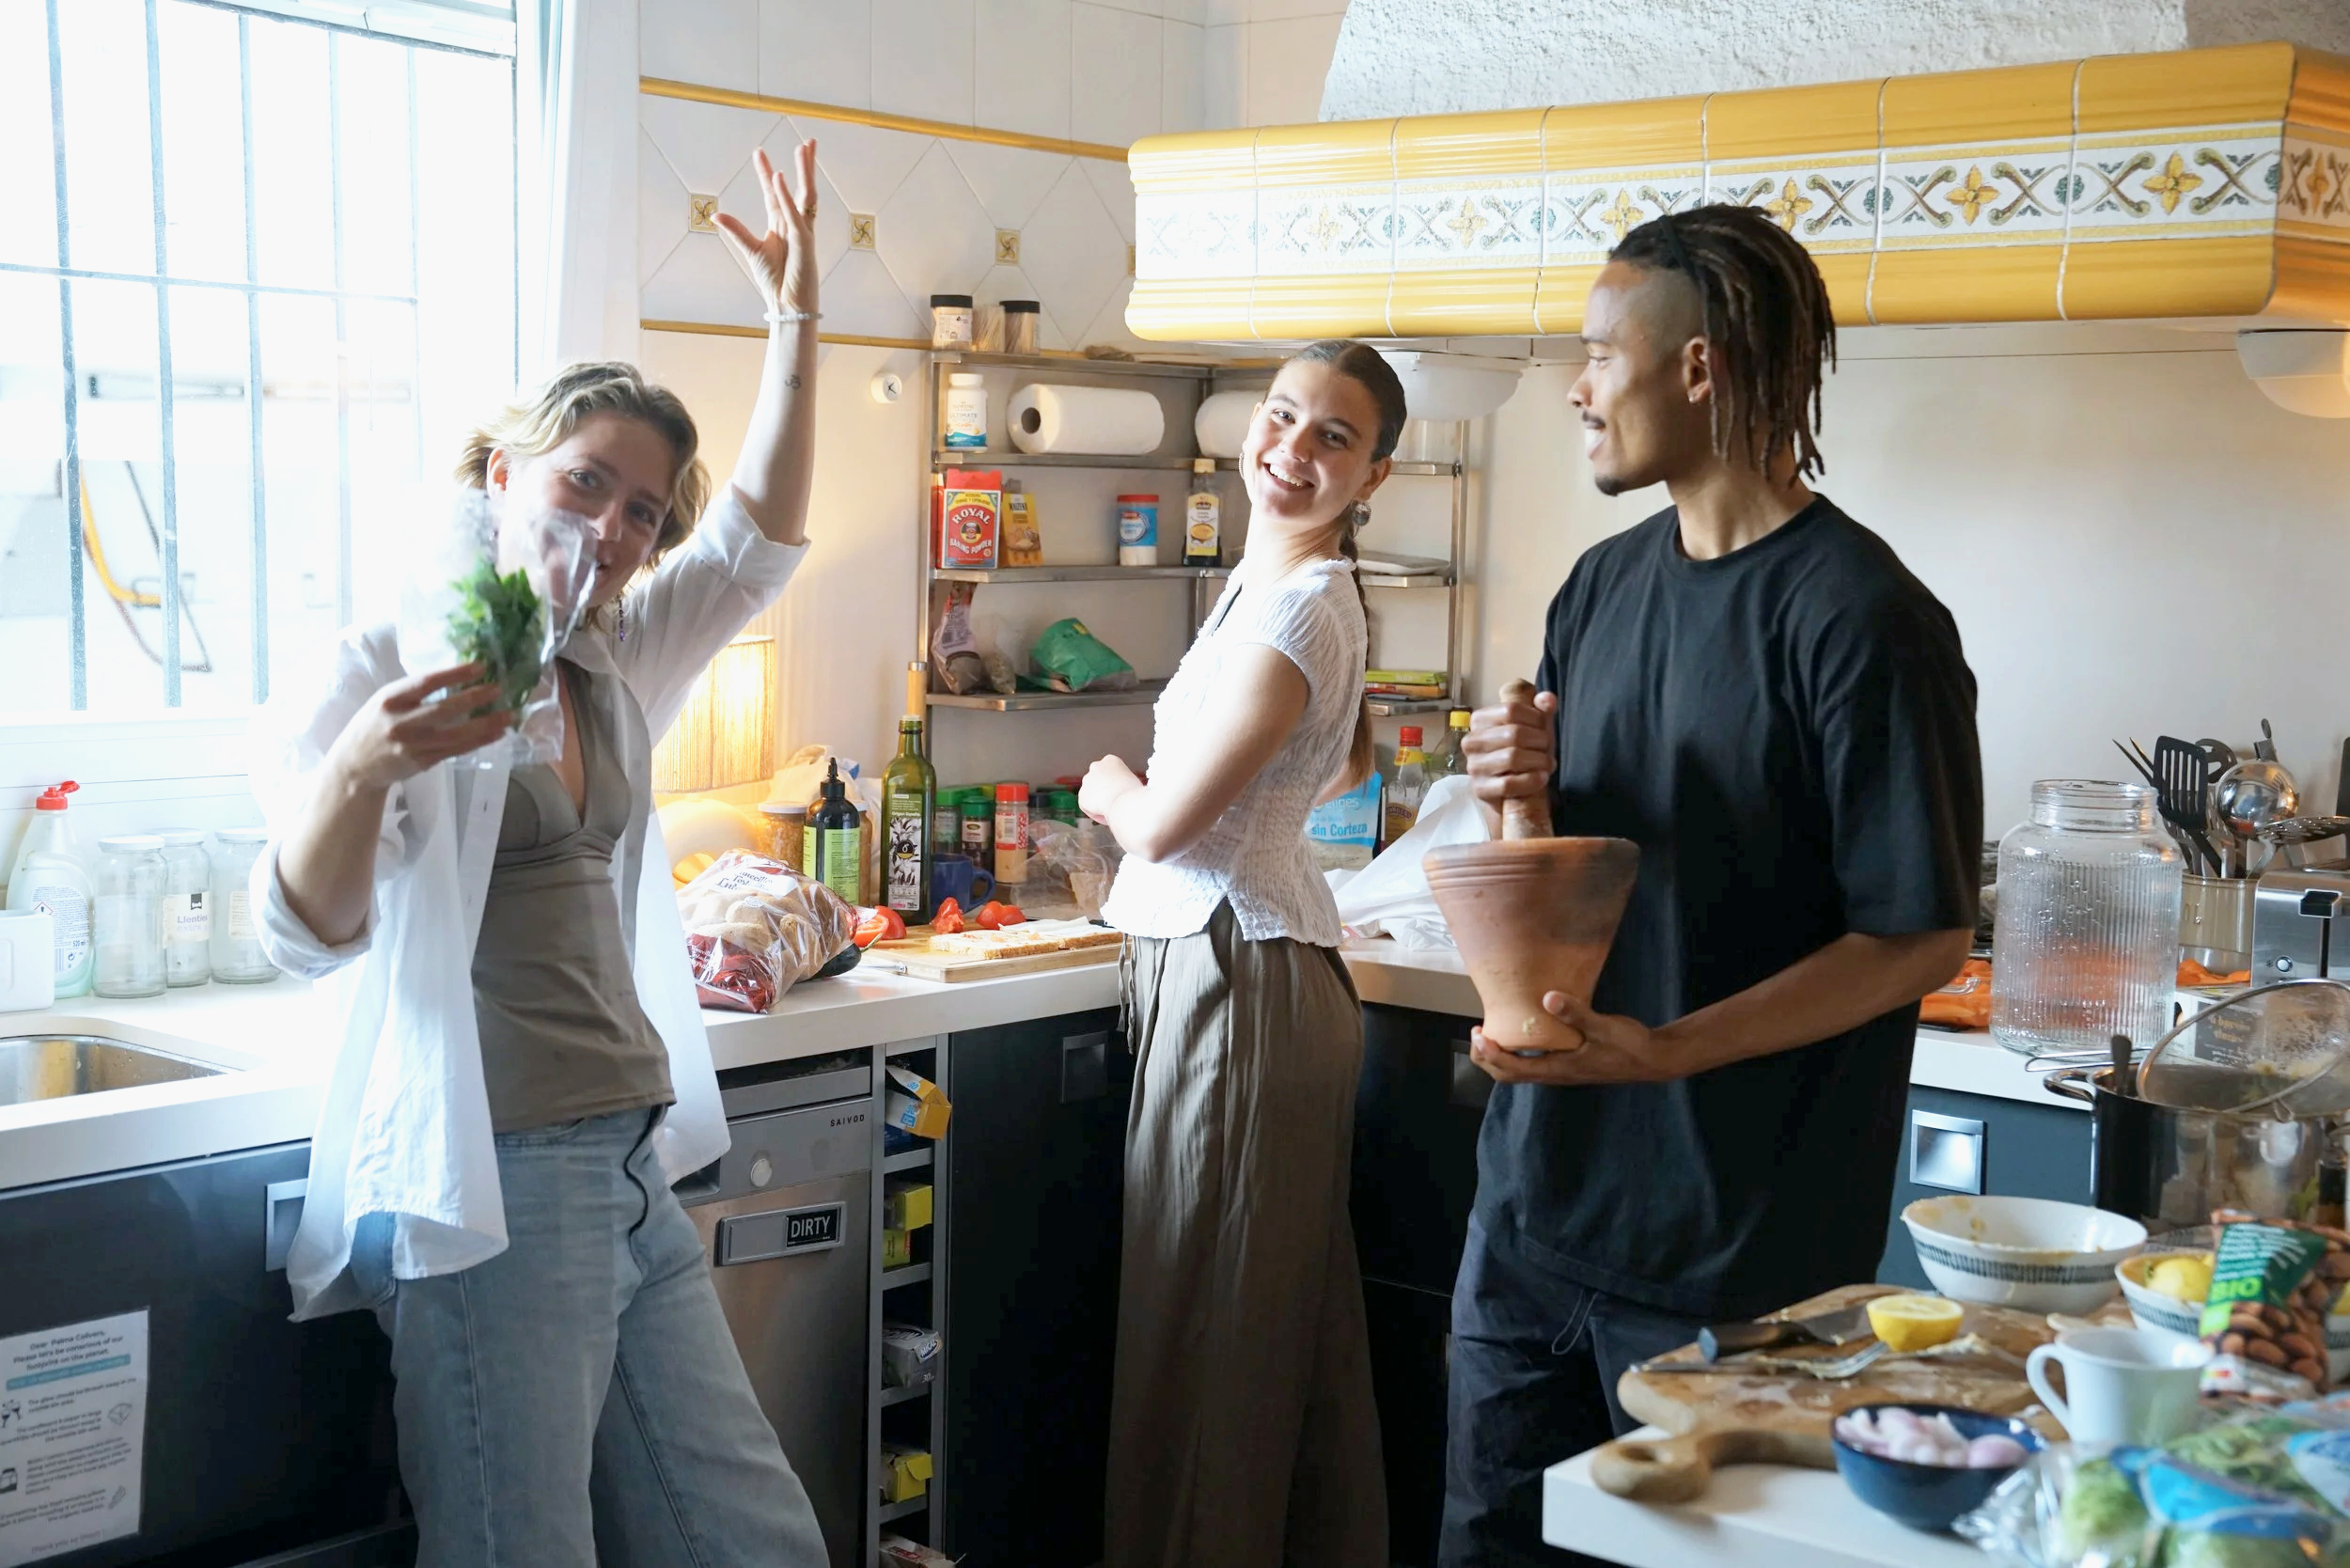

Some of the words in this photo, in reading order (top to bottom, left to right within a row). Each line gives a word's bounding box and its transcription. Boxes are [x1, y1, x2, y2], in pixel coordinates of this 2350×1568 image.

[951, 508, 992, 525] ROYAL
[949, 538, 970, 555] BAKING
[970, 539, 993, 555] POWDER
[1311, 823, 1326, 836] sin
[1330, 822, 1368, 837] Corteza
[830, 1114, 865, 1127] SAIVOD
[791, 1215, 831, 1238] DIRTY
[2210, 1277, 2262, 1302] BIO
